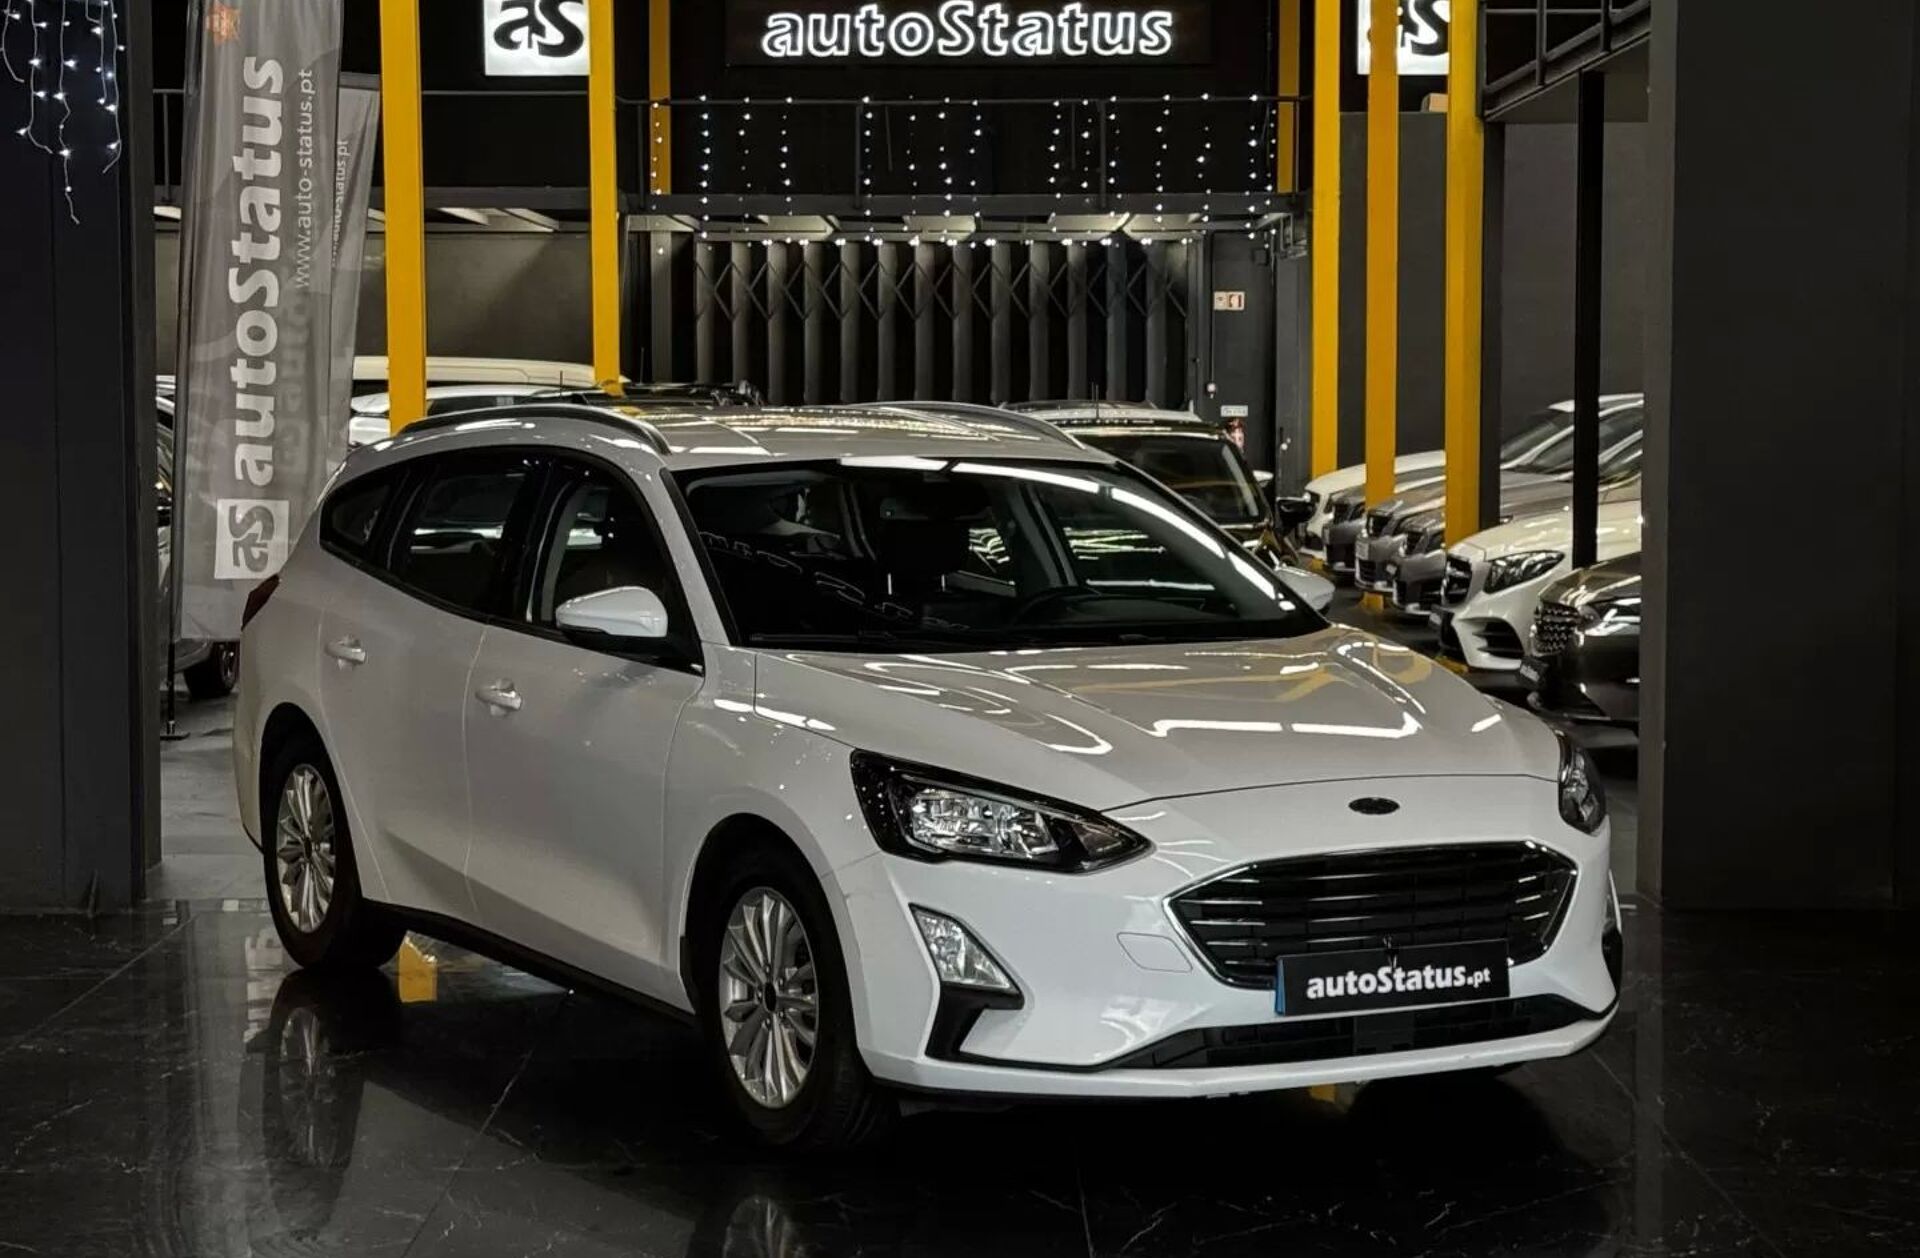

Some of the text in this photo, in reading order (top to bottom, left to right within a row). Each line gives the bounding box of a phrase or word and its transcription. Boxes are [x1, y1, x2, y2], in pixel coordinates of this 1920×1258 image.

[761, 0, 1173, 57] autoStatus
[295, 69, 316, 288] www.auto-status.pt
[228, 56, 283, 487] autoStatus
[1306, 965, 1491, 999] autoStatus.pt
